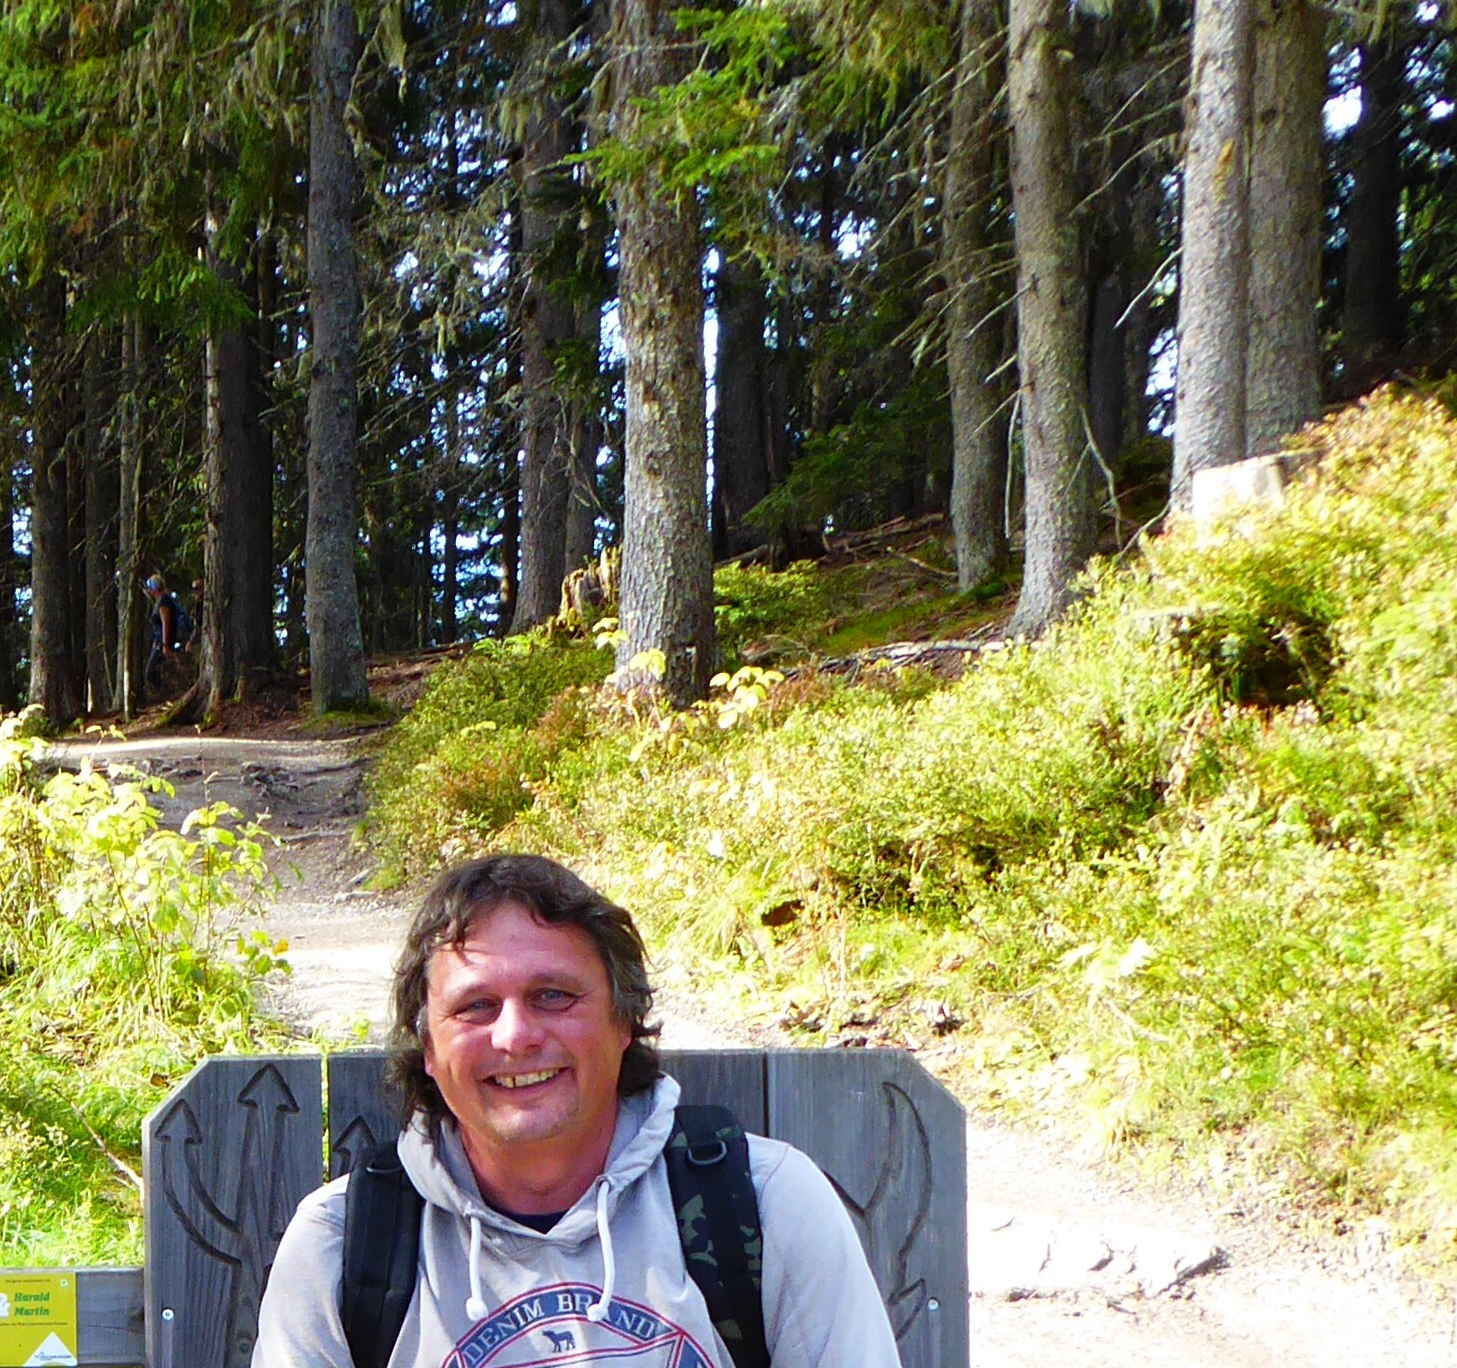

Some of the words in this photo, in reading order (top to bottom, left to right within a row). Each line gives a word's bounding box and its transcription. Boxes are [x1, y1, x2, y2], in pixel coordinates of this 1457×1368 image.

[14, 1291, 50, 1302] Harald
[14, 1306, 50, 1316] Martin
[463, 1298, 545, 1364] DENIM
[557, 1293, 657, 1338] BRND
